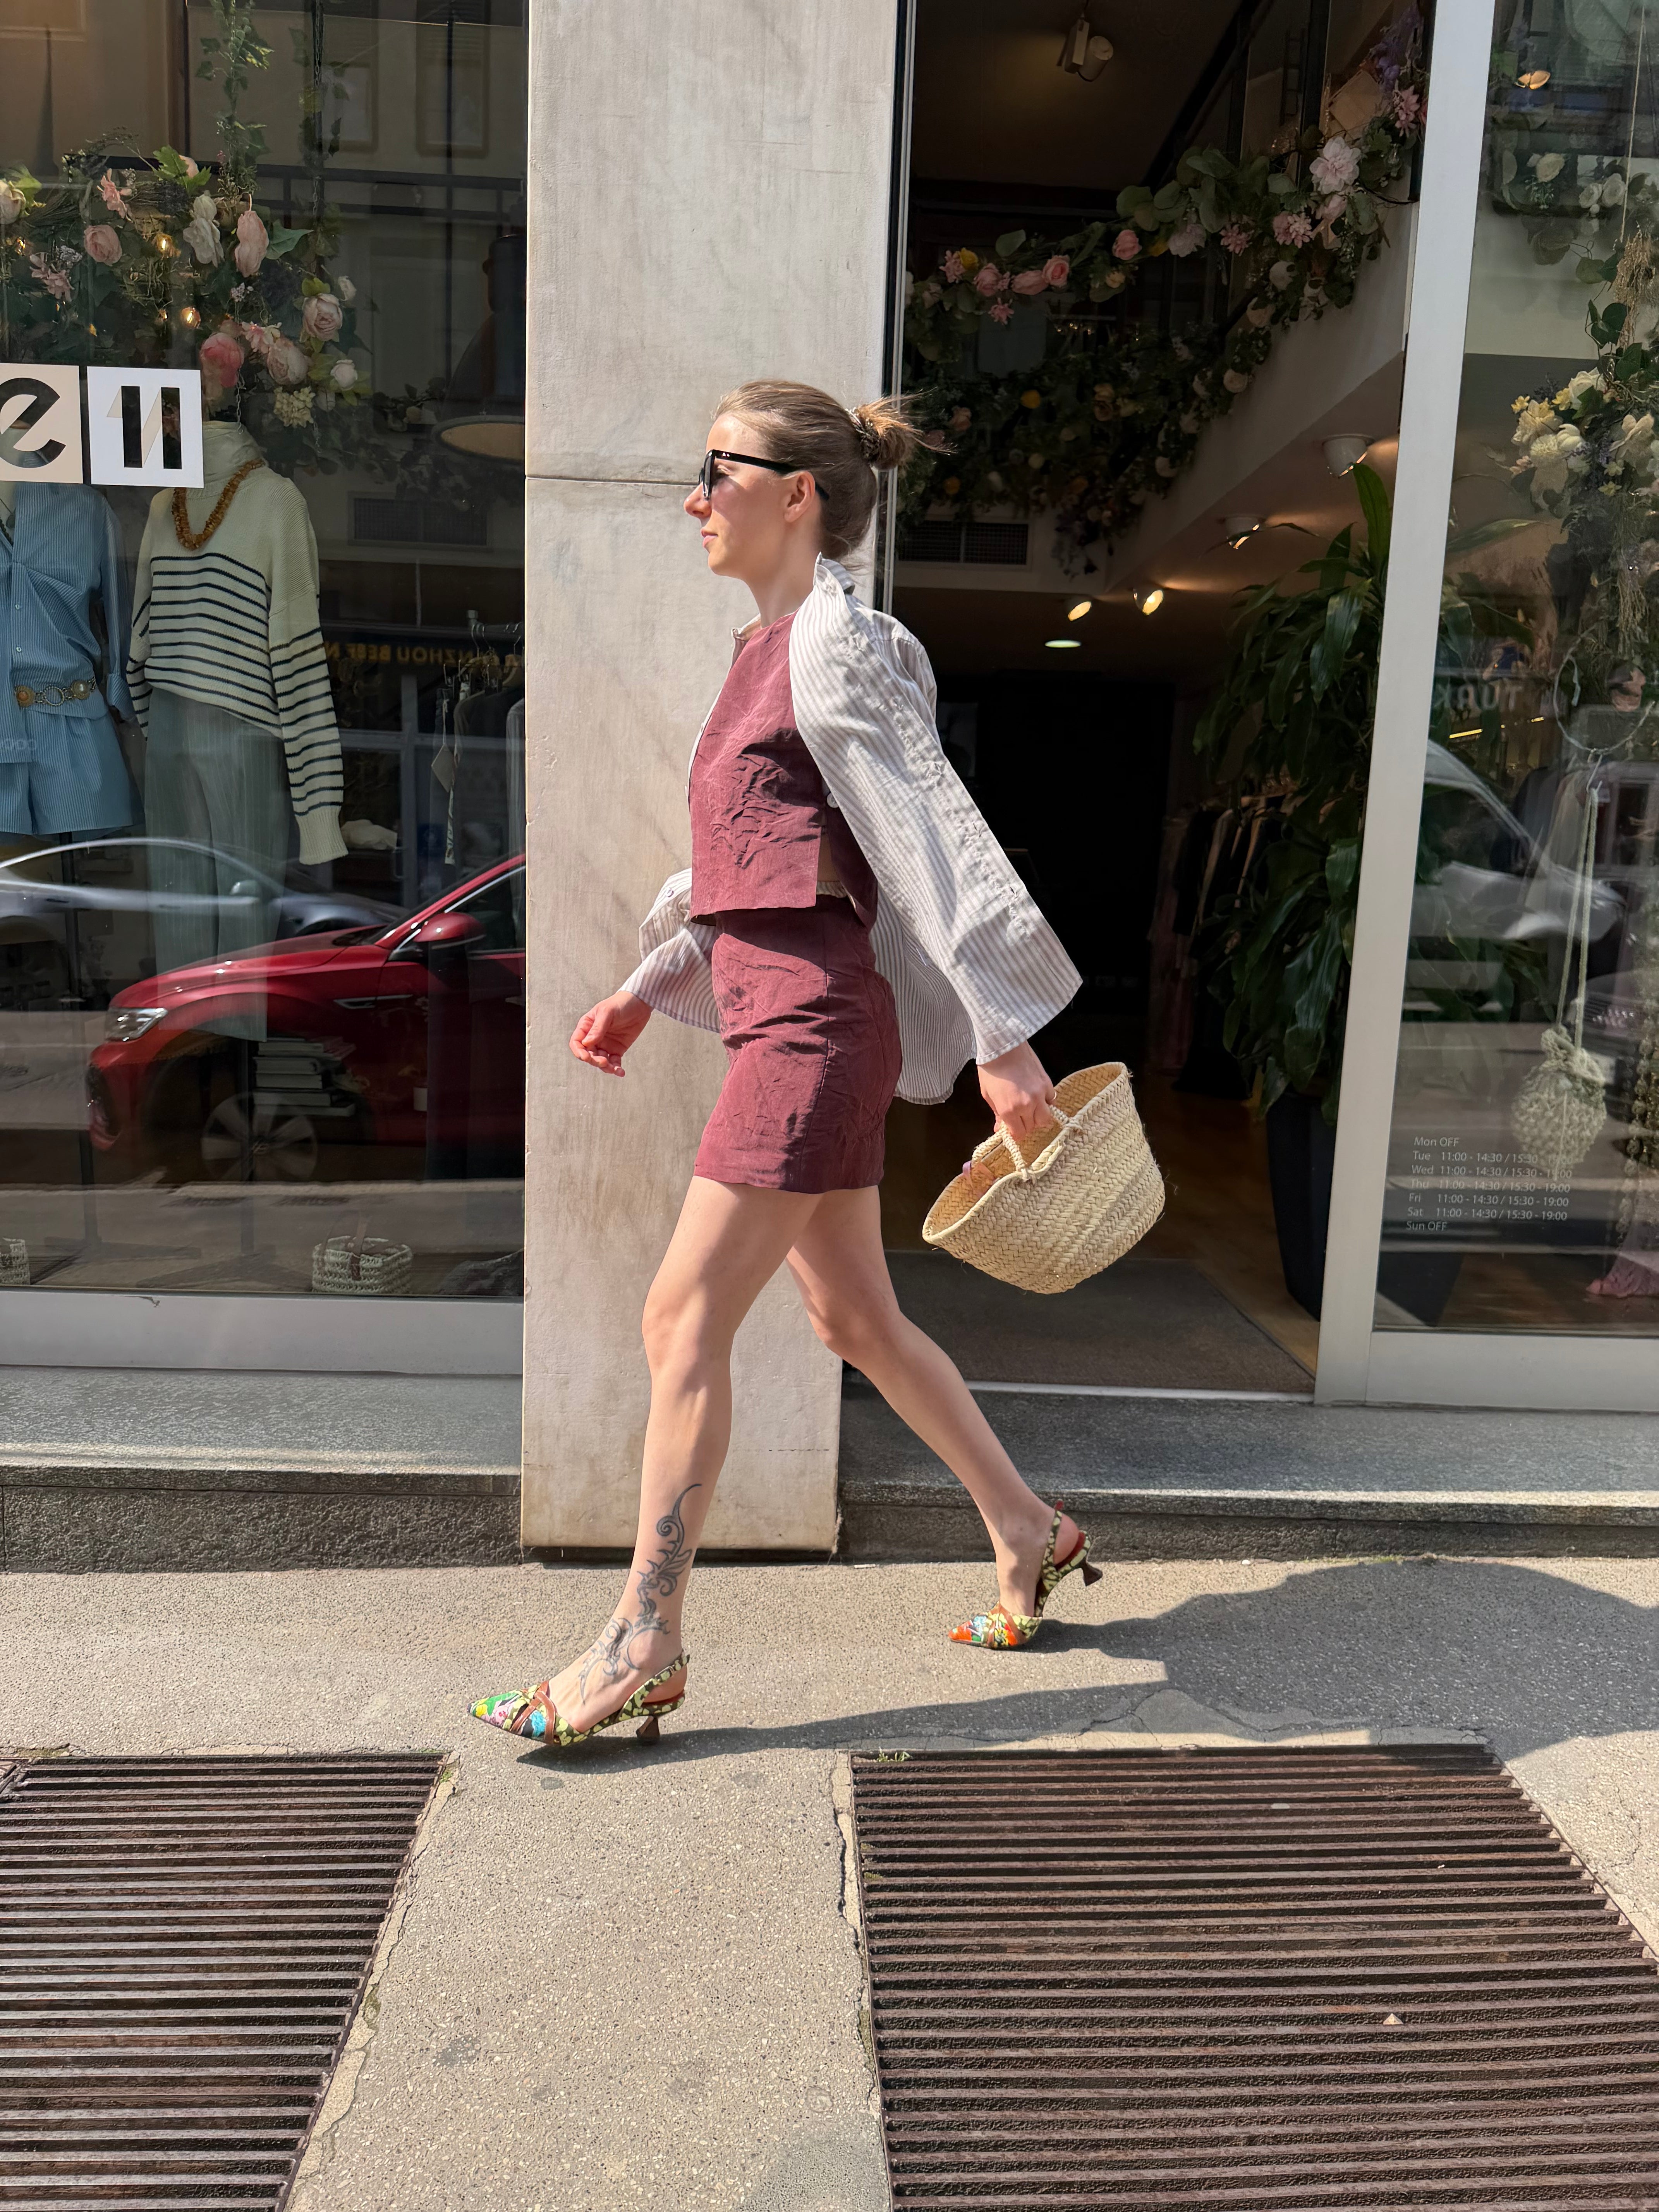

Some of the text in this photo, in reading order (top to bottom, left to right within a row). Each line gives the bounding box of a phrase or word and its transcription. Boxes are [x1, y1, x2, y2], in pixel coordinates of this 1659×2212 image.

[1414, 1137, 1459, 1147] Mon OFF
[1413, 1151, 1430, 1161] Tue
[1442, 1152, 1467, 1161] 11:00
[1477, 1152, 1502, 1163] 14:30
[1513, 1154, 1538, 1163] 15:30
[1548, 1155, 1573, 1164] 100
[1412, 1165, 1434, 1175] Wed
[1441, 1166, 1466, 1175] 11:00
[1476, 1167, 1501, 1177] 14:30
[1512, 1168, 1537, 1178] 15:30
[1547, 1169, 1572, 1178] 100
[1412, 1179, 1429, 1189] Thu
[1409, 1193, 1421, 1202] Fri
[1438, 1194, 1463, 1204] 11:00
[1473, 1195, 1498, 1205] 14:30
[1509, 1196, 1534, 1206] 15:30
[1543, 1197, 1569, 1207] 19:00
[1407, 1206, 1423, 1217] Sat
[1436, 1208, 1462, 1218] 11:00
[1472, 1209, 1497, 1219] 14:30
[1507, 1210, 1532, 1220] 15:30
[1542, 1211, 1568, 1221] 19:00
[1406, 1221, 1448, 1231] Sun OFF
